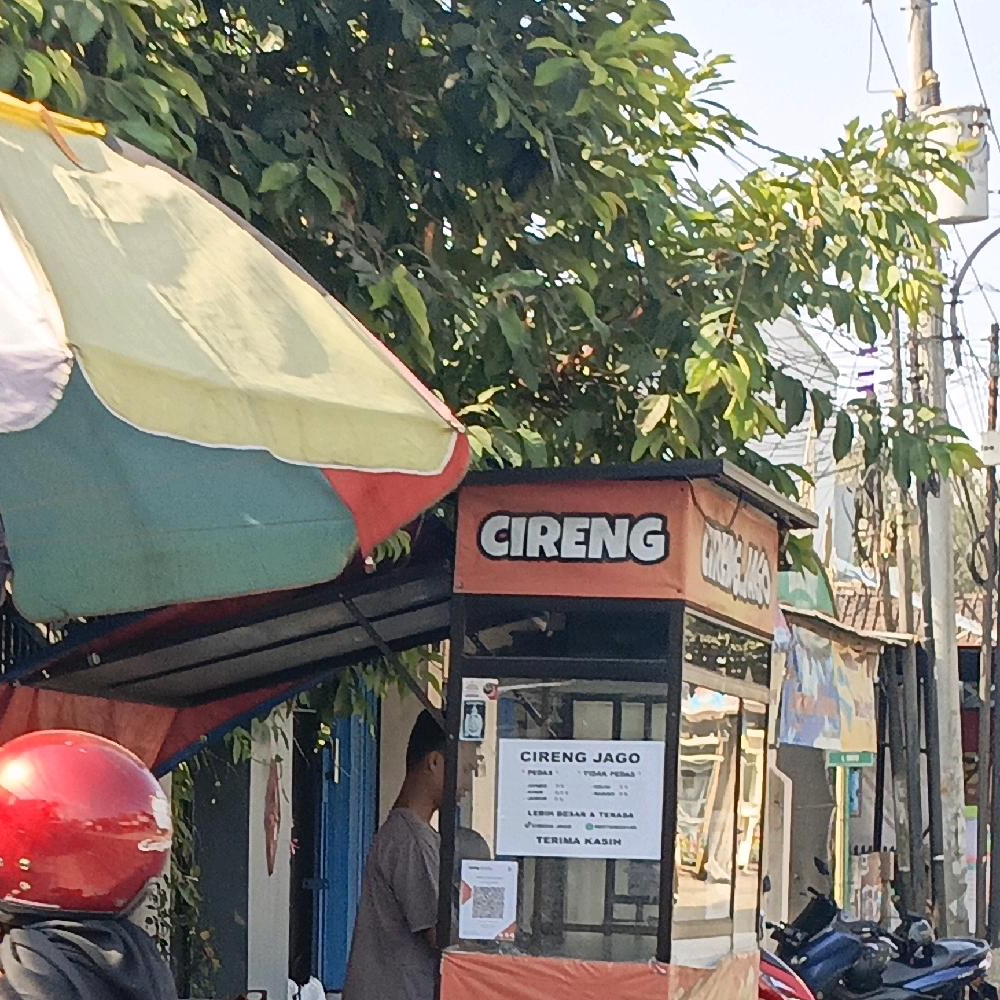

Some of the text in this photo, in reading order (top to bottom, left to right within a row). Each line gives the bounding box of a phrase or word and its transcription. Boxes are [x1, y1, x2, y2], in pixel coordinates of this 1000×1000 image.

[479, 512, 668, 564] CIRENG
[520, 751, 640, 764] CIRENG JAGO
[536, 836, 622, 846] TERIMA KASIH
